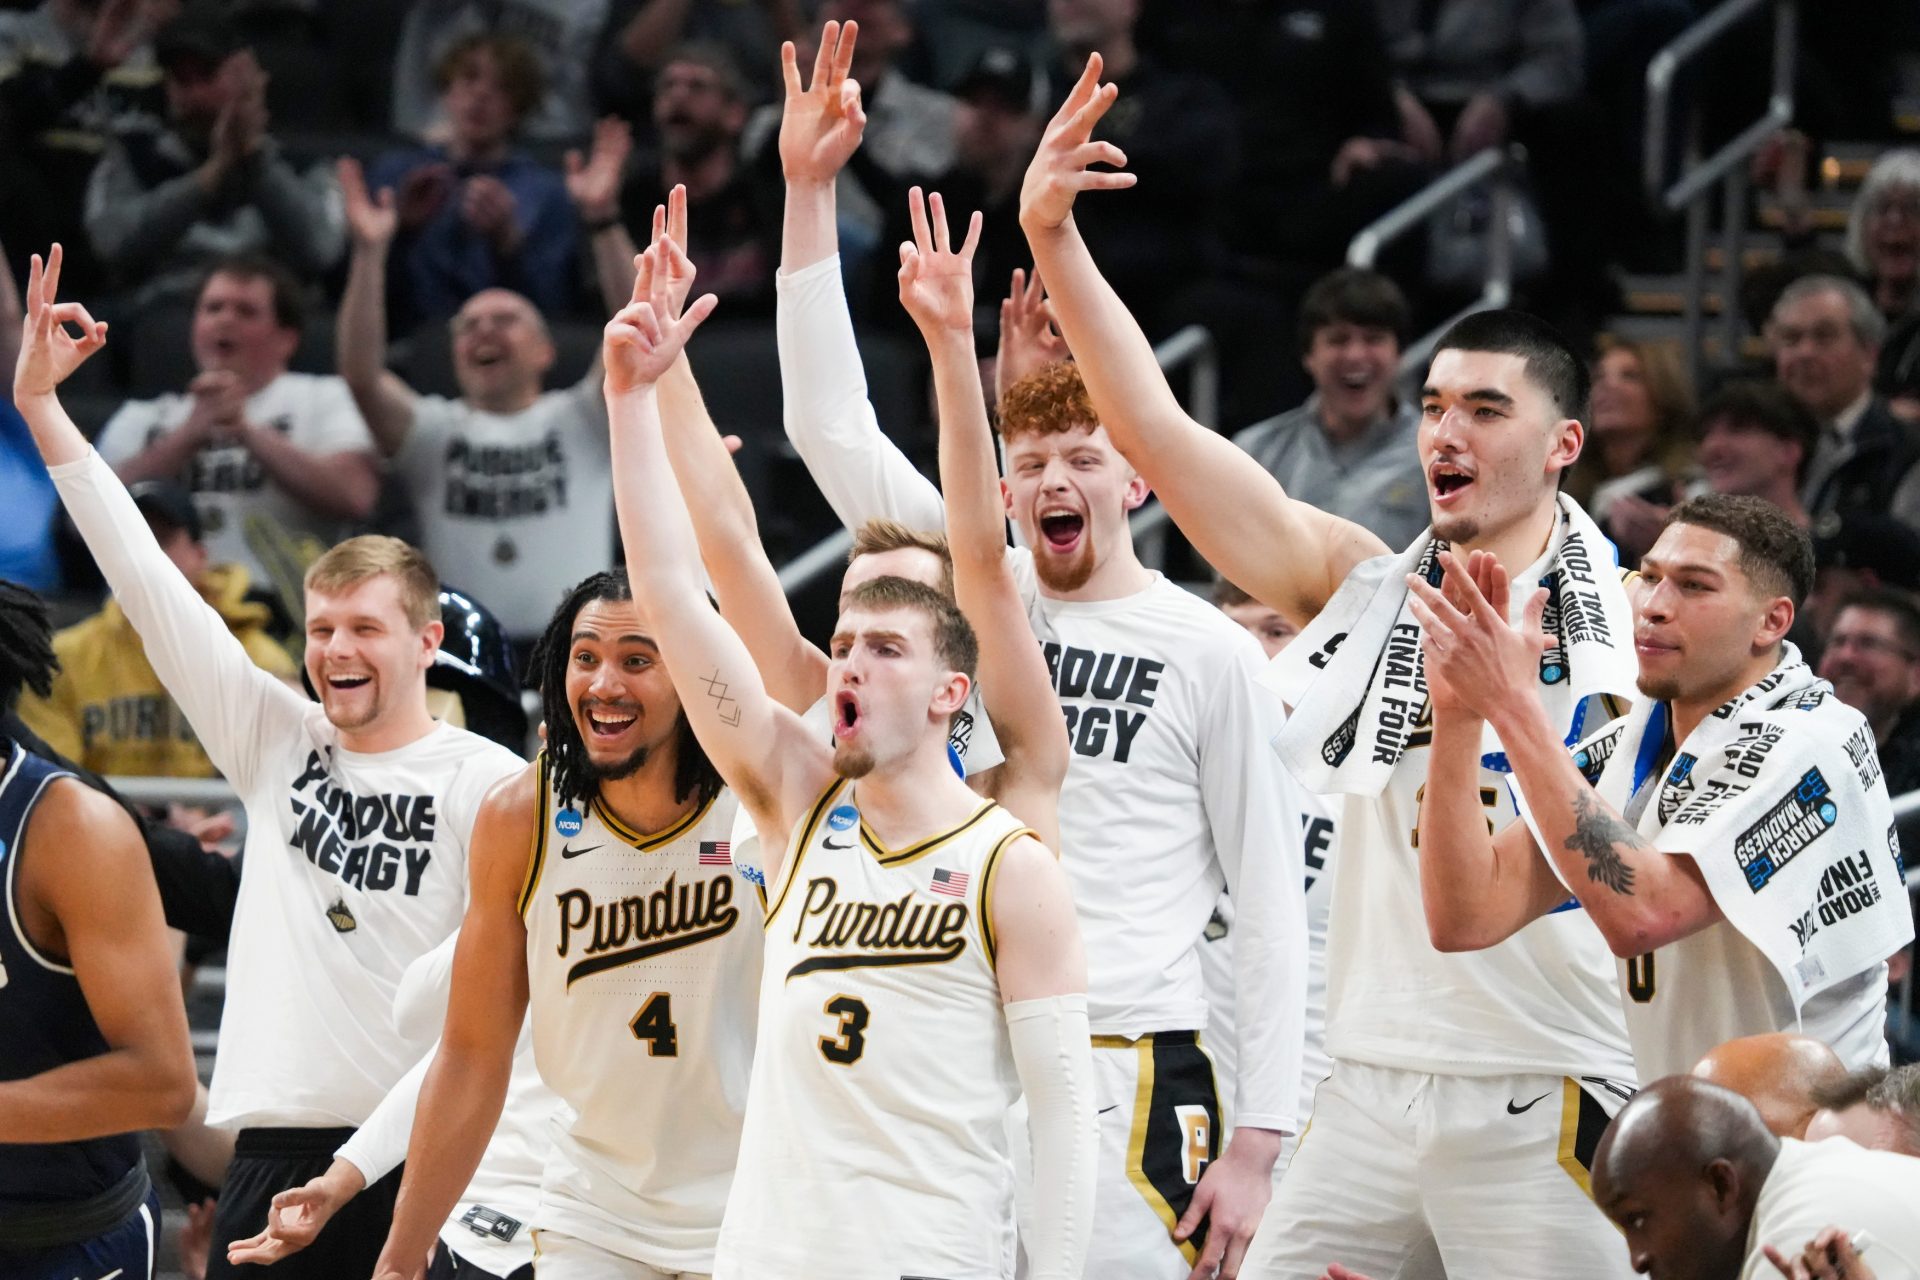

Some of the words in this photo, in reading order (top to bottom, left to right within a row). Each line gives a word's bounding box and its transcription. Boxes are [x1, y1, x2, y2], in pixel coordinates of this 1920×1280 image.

[1560, 590, 1589, 637] ROAD
[1571, 631, 1593, 646] THE
[1579, 591, 1615, 649] FINAL
[1384, 623, 1420, 689] FINAL
[1372, 696, 1408, 766] FOUR
[1738, 733, 1782, 779] ROAD
[557, 820, 581, 831] NCAA
[1736, 798, 1804, 868] MADNESS
[1767, 810, 1826, 868] MARCH
[555, 869, 736, 959] Purdue
[793, 877, 968, 950] Purdue
[1818, 883, 1876, 927] ROAD
[1868, 878, 1882, 903] THE
[628, 991, 678, 1057] 4
[817, 993, 871, 1067] 3
[495, 1221, 510, 1233] 44
